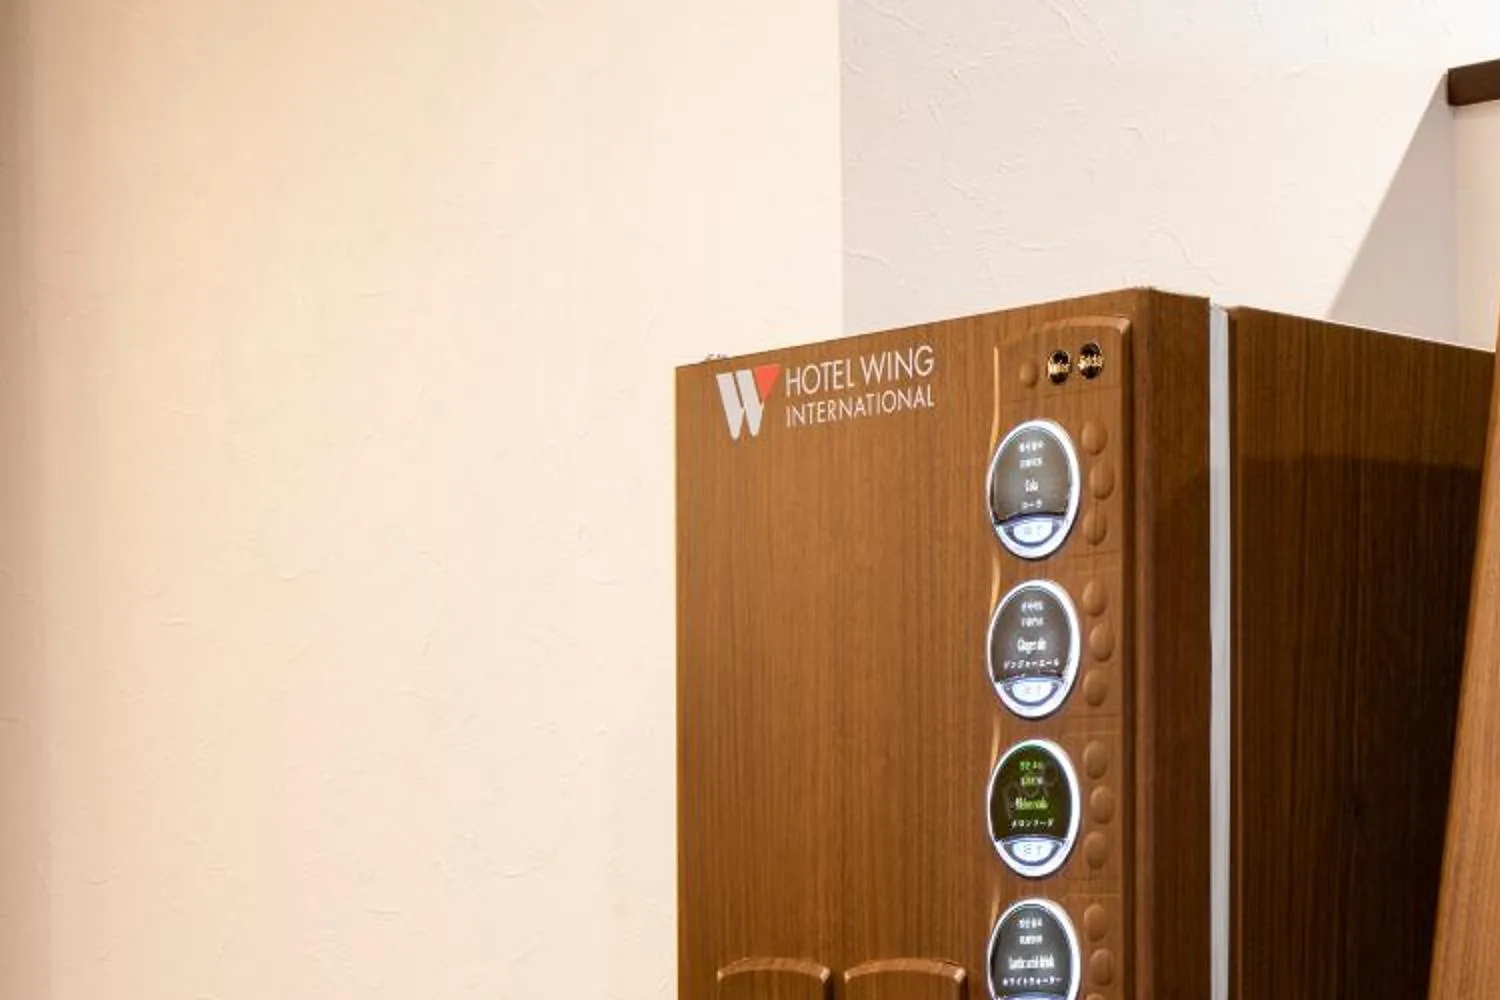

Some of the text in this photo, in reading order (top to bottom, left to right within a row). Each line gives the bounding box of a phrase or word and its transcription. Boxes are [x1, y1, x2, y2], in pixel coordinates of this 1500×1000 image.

[786, 345, 935, 397] HOTEL WING
[786, 384, 935, 428] INTERNATIONAL
